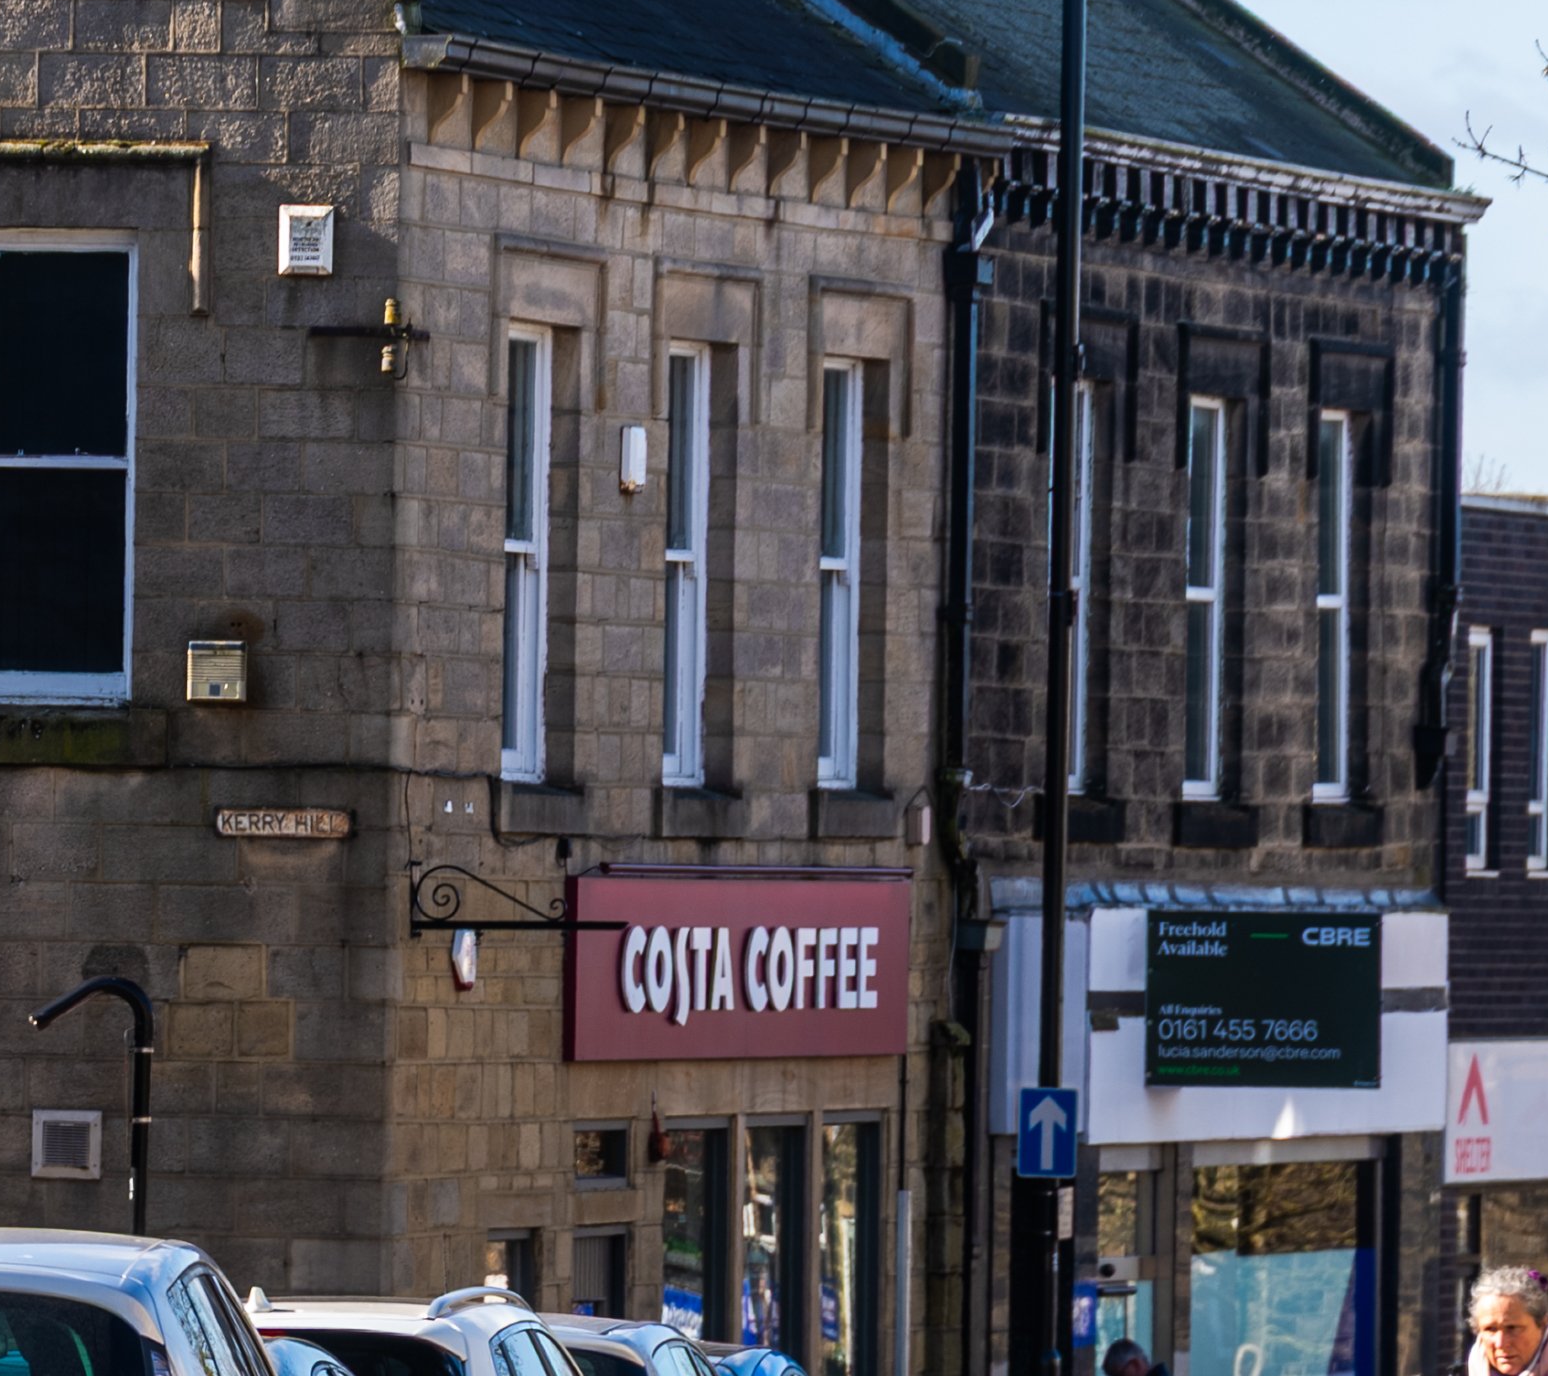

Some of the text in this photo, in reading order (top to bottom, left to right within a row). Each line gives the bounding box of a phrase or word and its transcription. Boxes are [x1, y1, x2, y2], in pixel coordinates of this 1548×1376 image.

[221, 813, 286, 832] KERRY
[1158, 921, 1372, 947] Freehold CBRE
[1157, 939, 1229, 958] Available
[620, 925, 880, 1027] COSTA COFFEE
[1158, 1019, 1319, 1042] 0161 455 7666
